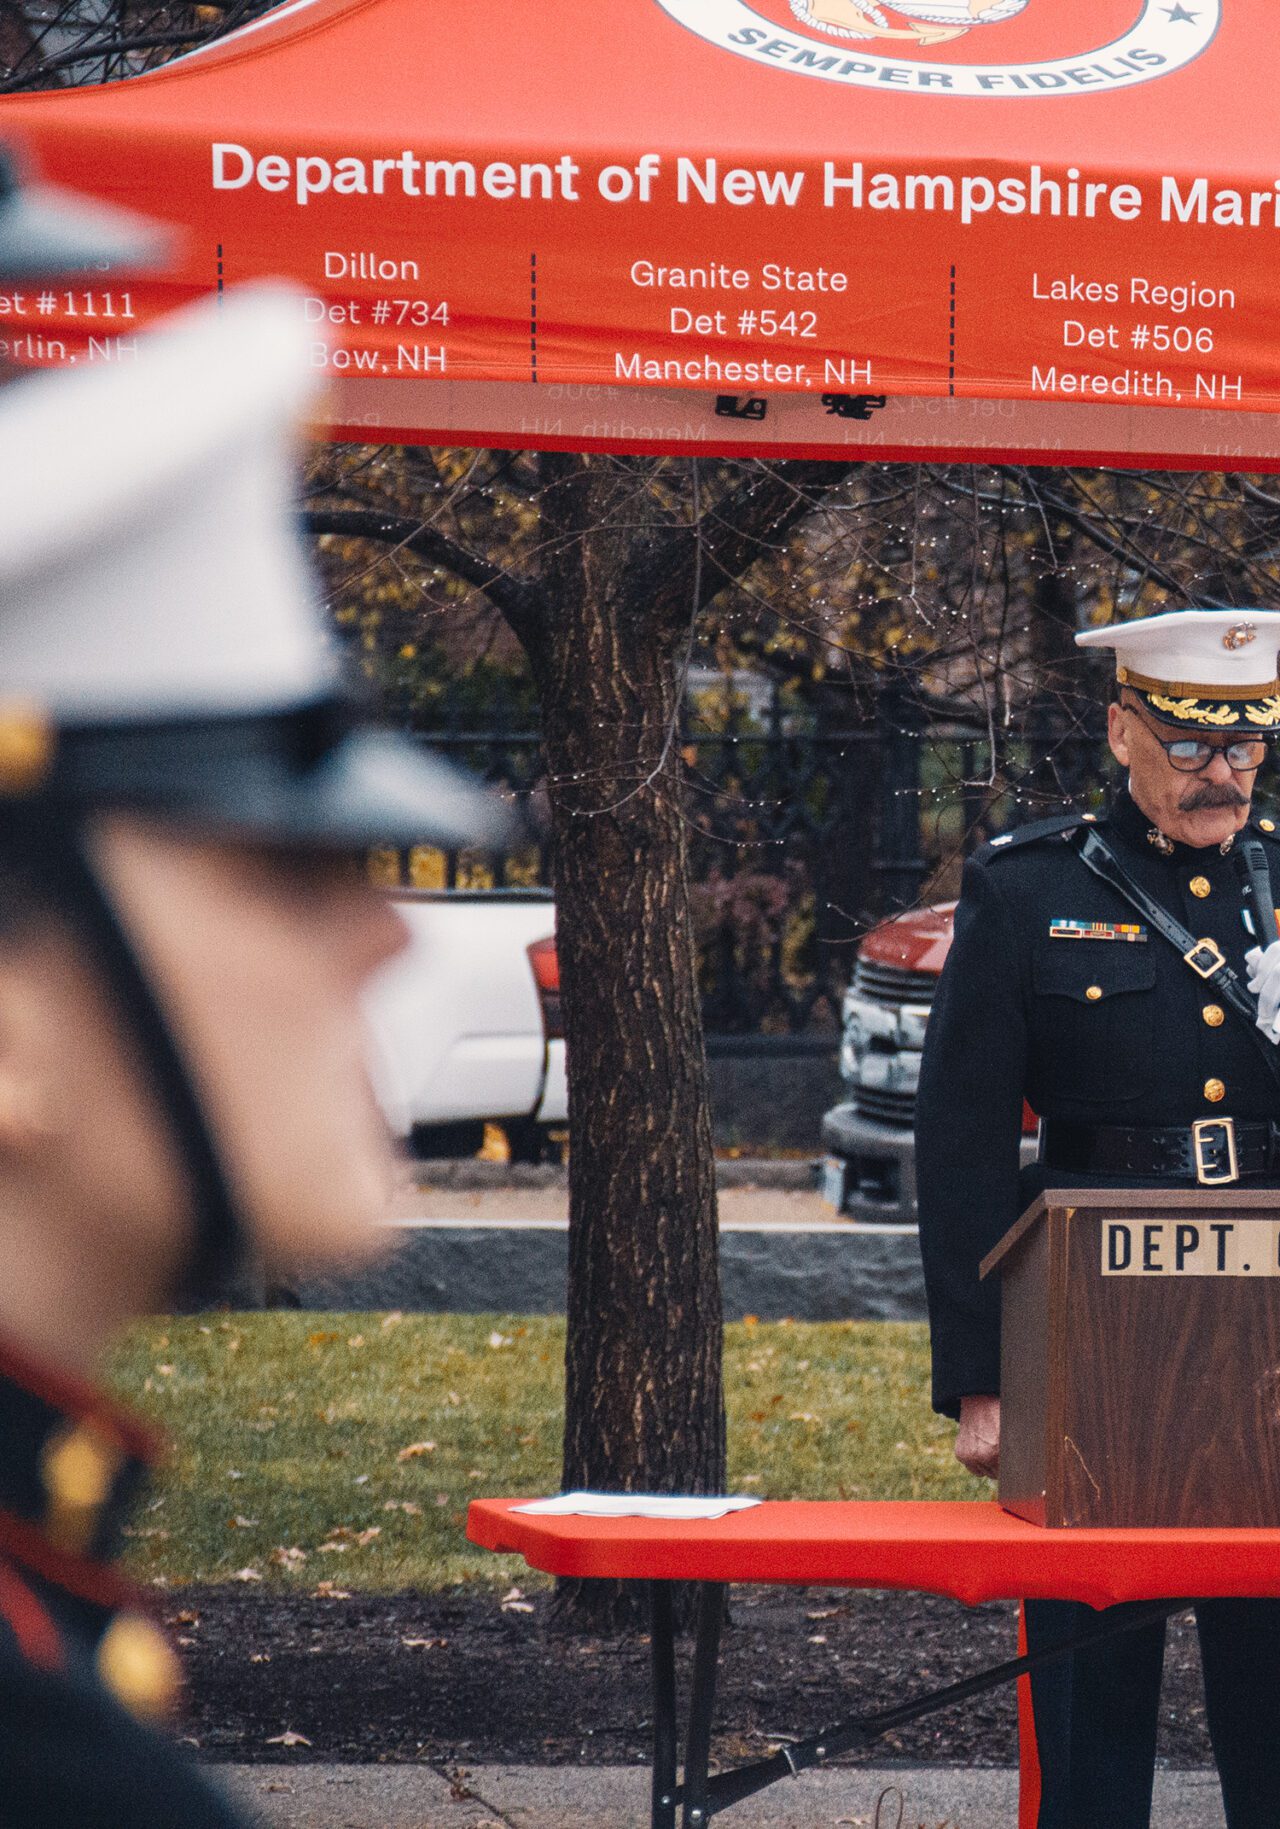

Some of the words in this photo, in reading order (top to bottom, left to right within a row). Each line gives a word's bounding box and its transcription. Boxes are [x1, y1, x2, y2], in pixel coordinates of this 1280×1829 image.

[727, 26, 953, 90] SEMPER
[975, 46, 1168, 92] FIDELIS
[211, 142, 580, 205] Department
[597, 154, 660, 203] of
[676, 157, 805, 208] New
[823, 161, 1143, 224] Hampshire
[323, 250, 421, 282] Dillon
[629, 258, 752, 291] Granite
[760, 262, 849, 294] State
[0, 291, 27, 317] et
[35, 290, 136, 319] #1111
[1031, 271, 1120, 304] Lakes
[1129, 276, 1237, 314] Region
[303, 298, 361, 325] Det
[371, 299, 450, 327] #734
[669, 306, 728, 337] Det
[736, 308, 819, 339] #542
[0, 334, 77, 363] erlin,
[1062, 319, 1121, 350] Det
[1129, 323, 1215, 355] #506
[309, 342, 389, 374] Bow,
[396, 343, 448, 372] NH
[613, 350, 813, 387] Manchester,
[822, 357, 877, 386] NH
[1029, 364, 1183, 402] Meredith,
[1194, 372, 1243, 401] NH
[1107, 1223, 1251, 1272] DEPT.
